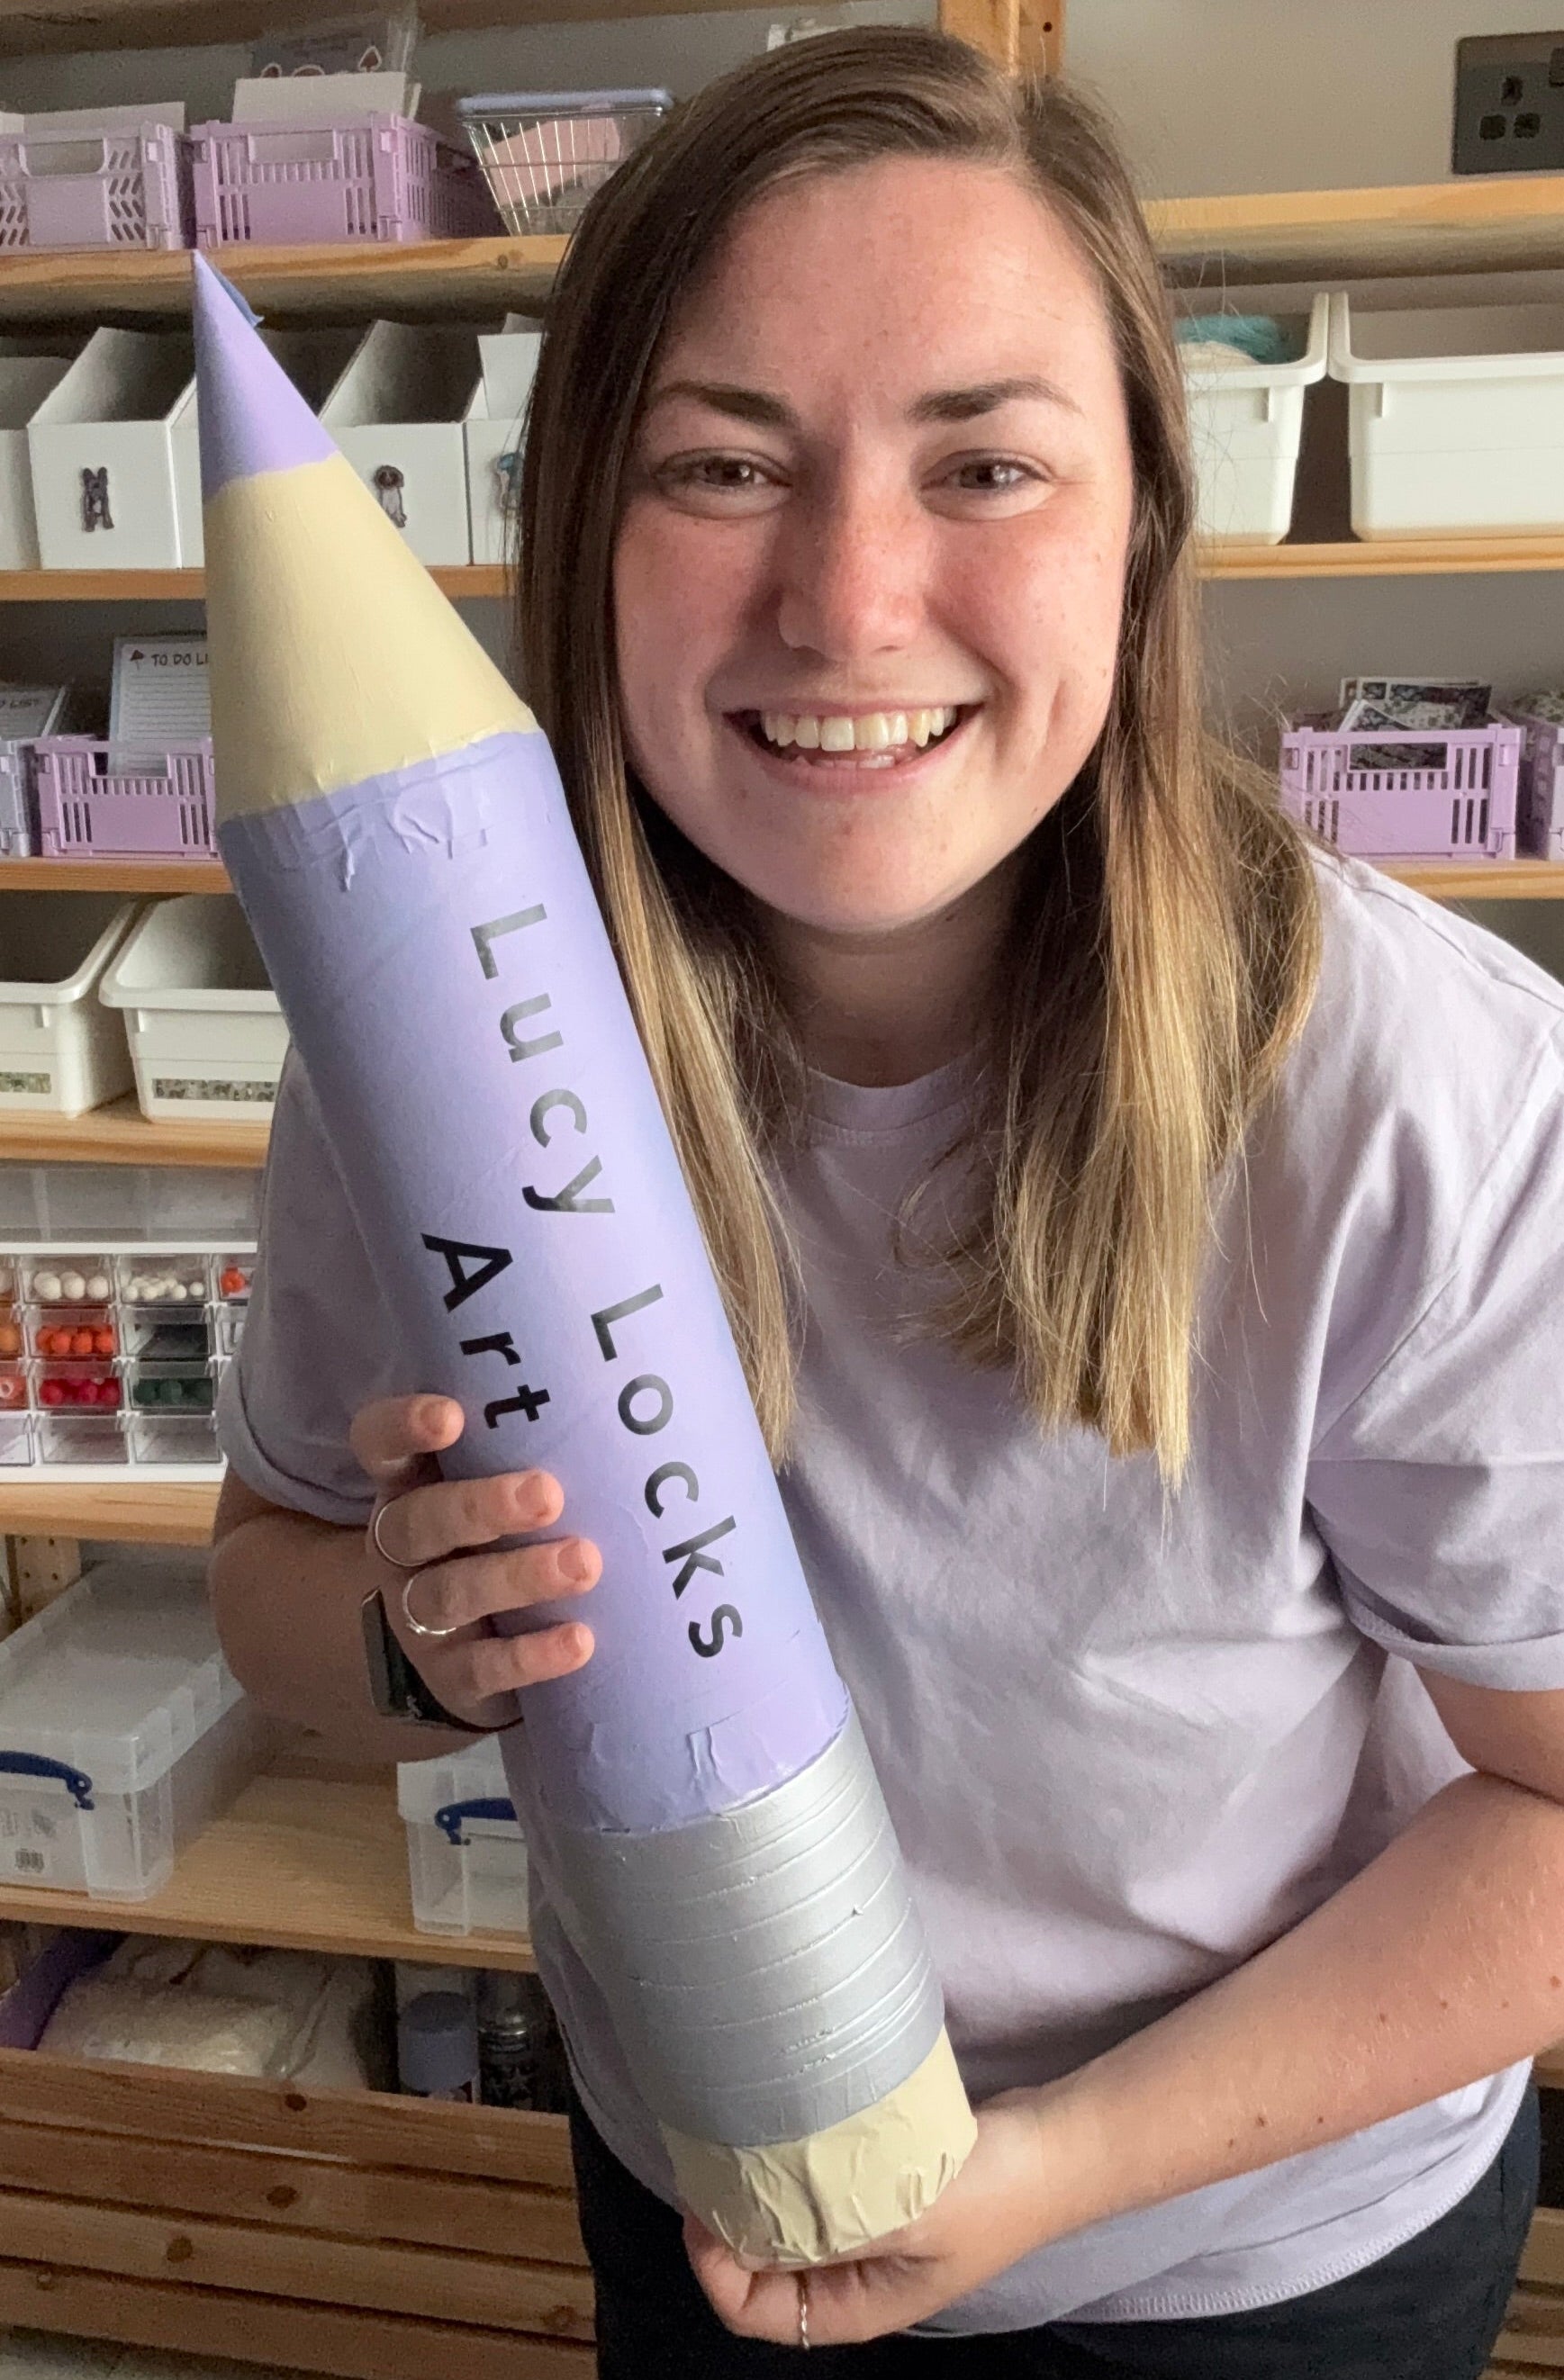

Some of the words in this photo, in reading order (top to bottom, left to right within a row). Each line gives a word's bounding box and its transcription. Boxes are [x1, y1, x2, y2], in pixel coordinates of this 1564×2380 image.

[151, 654, 168, 667] TO
[173, 654, 192, 665] DO
[196, 653, 208, 665] LI
[421, 1233, 551, 1429] Art
[470, 903, 615, 1213] Lucy
[591, 1285, 743, 1658] Locks
